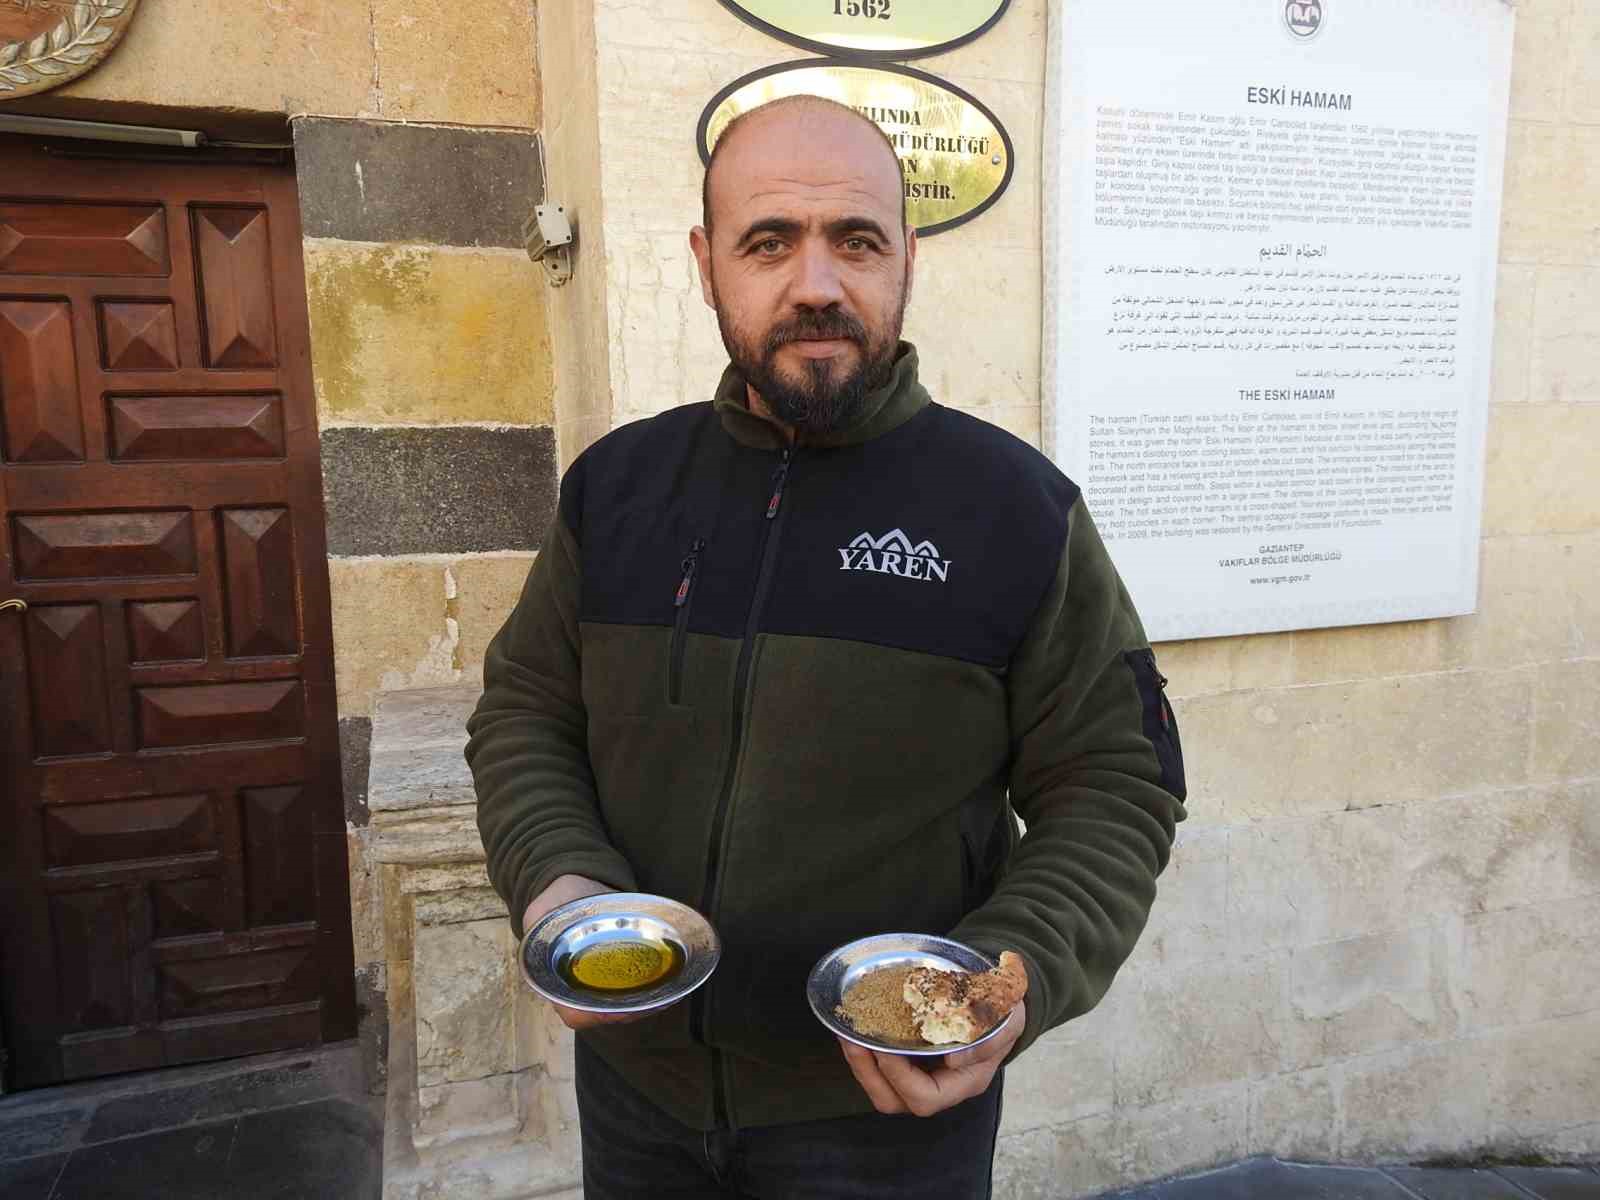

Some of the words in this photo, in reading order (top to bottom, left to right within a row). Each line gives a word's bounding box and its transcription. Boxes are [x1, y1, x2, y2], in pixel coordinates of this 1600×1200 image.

[833, 0, 889, 20] 1562
[1247, 84, 1286, 105] ESKİ
[1290, 89, 1352, 111] HAMAM
[1239, 389, 1261, 401] THE
[1294, 388, 1336, 401] HAMAM
[1090, 415, 1105, 424] The
[838, 548, 952, 582] YAREN
